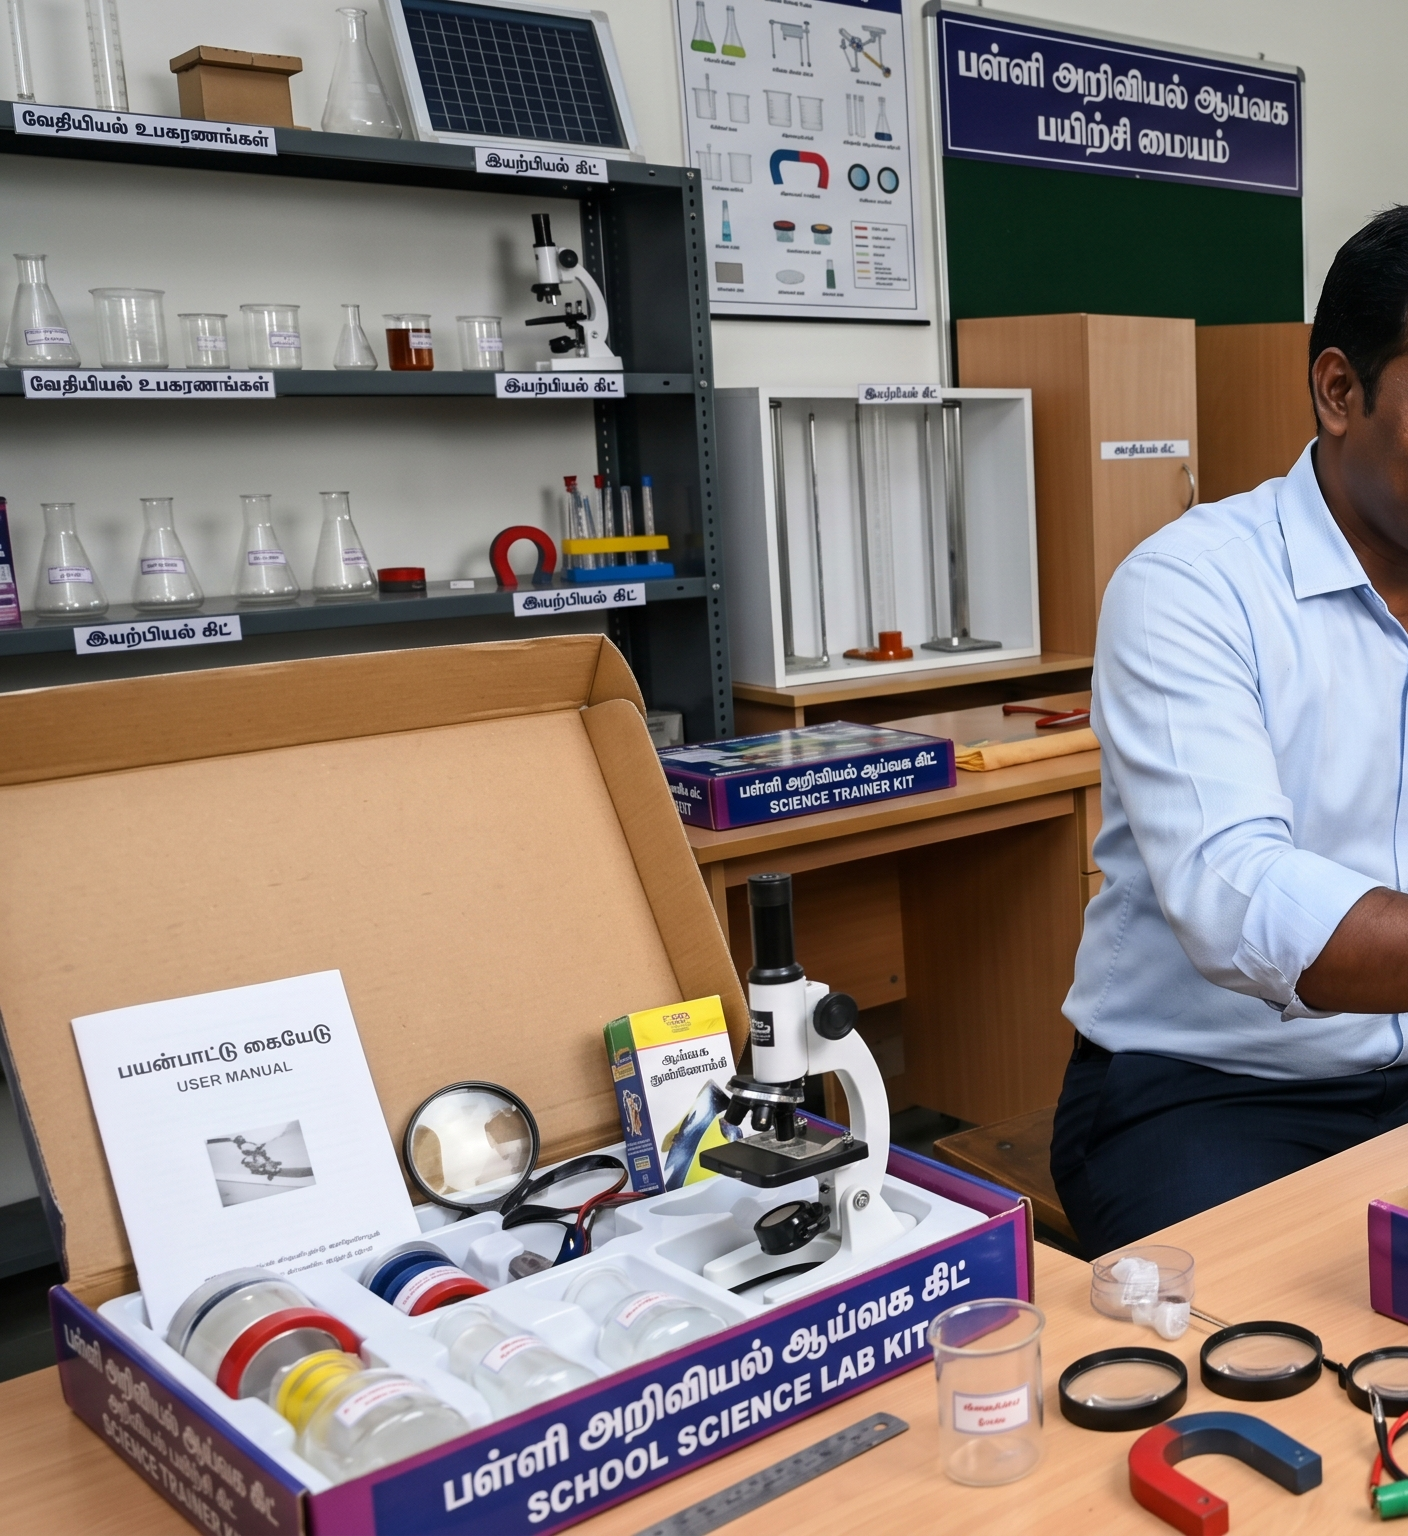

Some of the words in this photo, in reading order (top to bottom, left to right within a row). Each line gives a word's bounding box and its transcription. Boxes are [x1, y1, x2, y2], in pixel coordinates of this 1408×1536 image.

[958, 43, 1044, 88] பள்ளி
[1052, 62, 1188, 110] அறிவியல்
[1194, 84, 1289, 126] ஆய்வக
[22, 110, 128, 134] வேதியியல்
[135, 123, 269, 148] உபகரணங்கள்
[1038, 111, 1131, 156] பயிற்சி
[1138, 128, 1229, 163] மையம்
[485, 152, 570, 174] இயற்பியல்
[576, 159, 600, 176] கிட்
[30, 375, 133, 396] வேதியியல்
[139, 375, 270, 395] உபகரணங்கள்
[504, 377, 589, 397] இயற்பியல்
[594, 377, 619, 393] கிட்
[613, 588, 637, 602] கிட்
[86, 623, 196, 648] இயற்பியல்
[202, 621, 232, 638] கிட்
[770, 791, 830, 813] SCIENCE
[832, 780, 890, 802] TRAINER
[893, 775, 915, 791] KIT
[117, 1040, 238, 1080] பயன்பாட்டு
[243, 1023, 332, 1055] கையேடு
[176, 1073, 223, 1093] USER
[226, 1061, 293, 1085] MANUAL
[442, 1422, 568, 1513] பள்ளி
[579, 1339, 774, 1453] அறிவியல்
[781, 1288, 914, 1361] ஆய்வக
[921, 1259, 971, 1304] கிட்
[526, 1439, 670, 1524] SCHOOL
[676, 1373, 813, 1458] SCIENCE
[819, 1350, 876, 1394] LAB
[882, 1322, 929, 1374] KIT
[102, 1412, 159, 1480] SCIENCE
[158, 1462, 222, 1536] TRAINER
